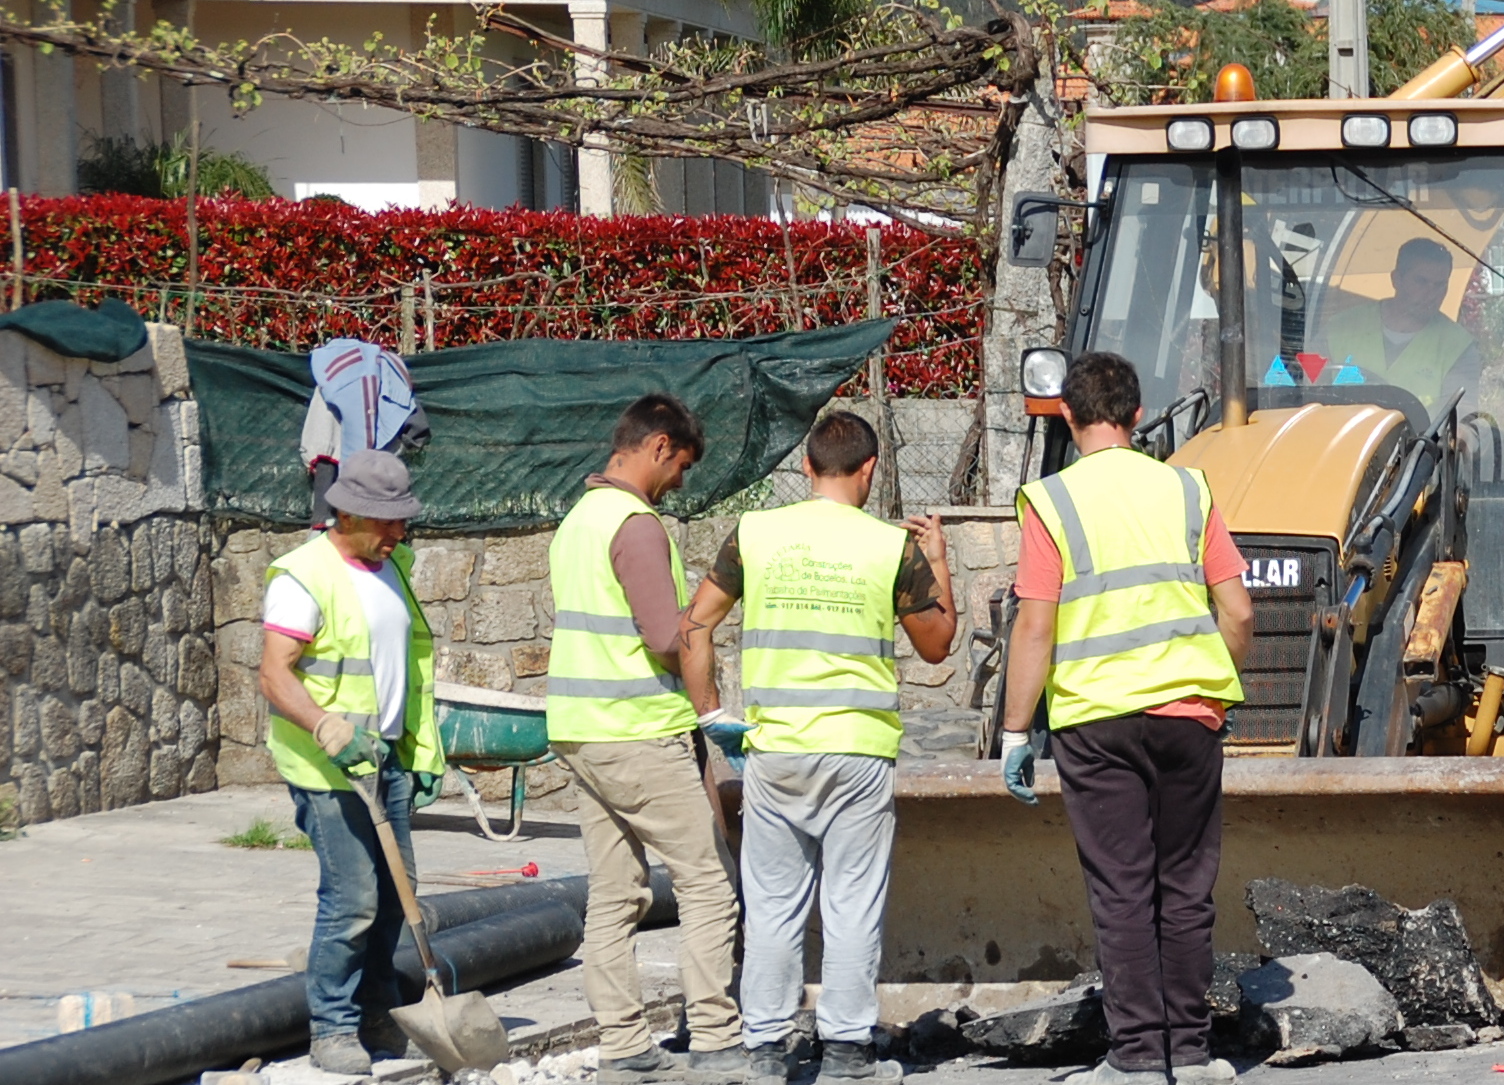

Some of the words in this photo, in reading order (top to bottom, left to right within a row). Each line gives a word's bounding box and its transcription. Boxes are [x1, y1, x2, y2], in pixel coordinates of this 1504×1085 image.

[801, 557, 853, 571] Construções
[801, 572, 812, 580] de
[797, 586, 807, 595] de
